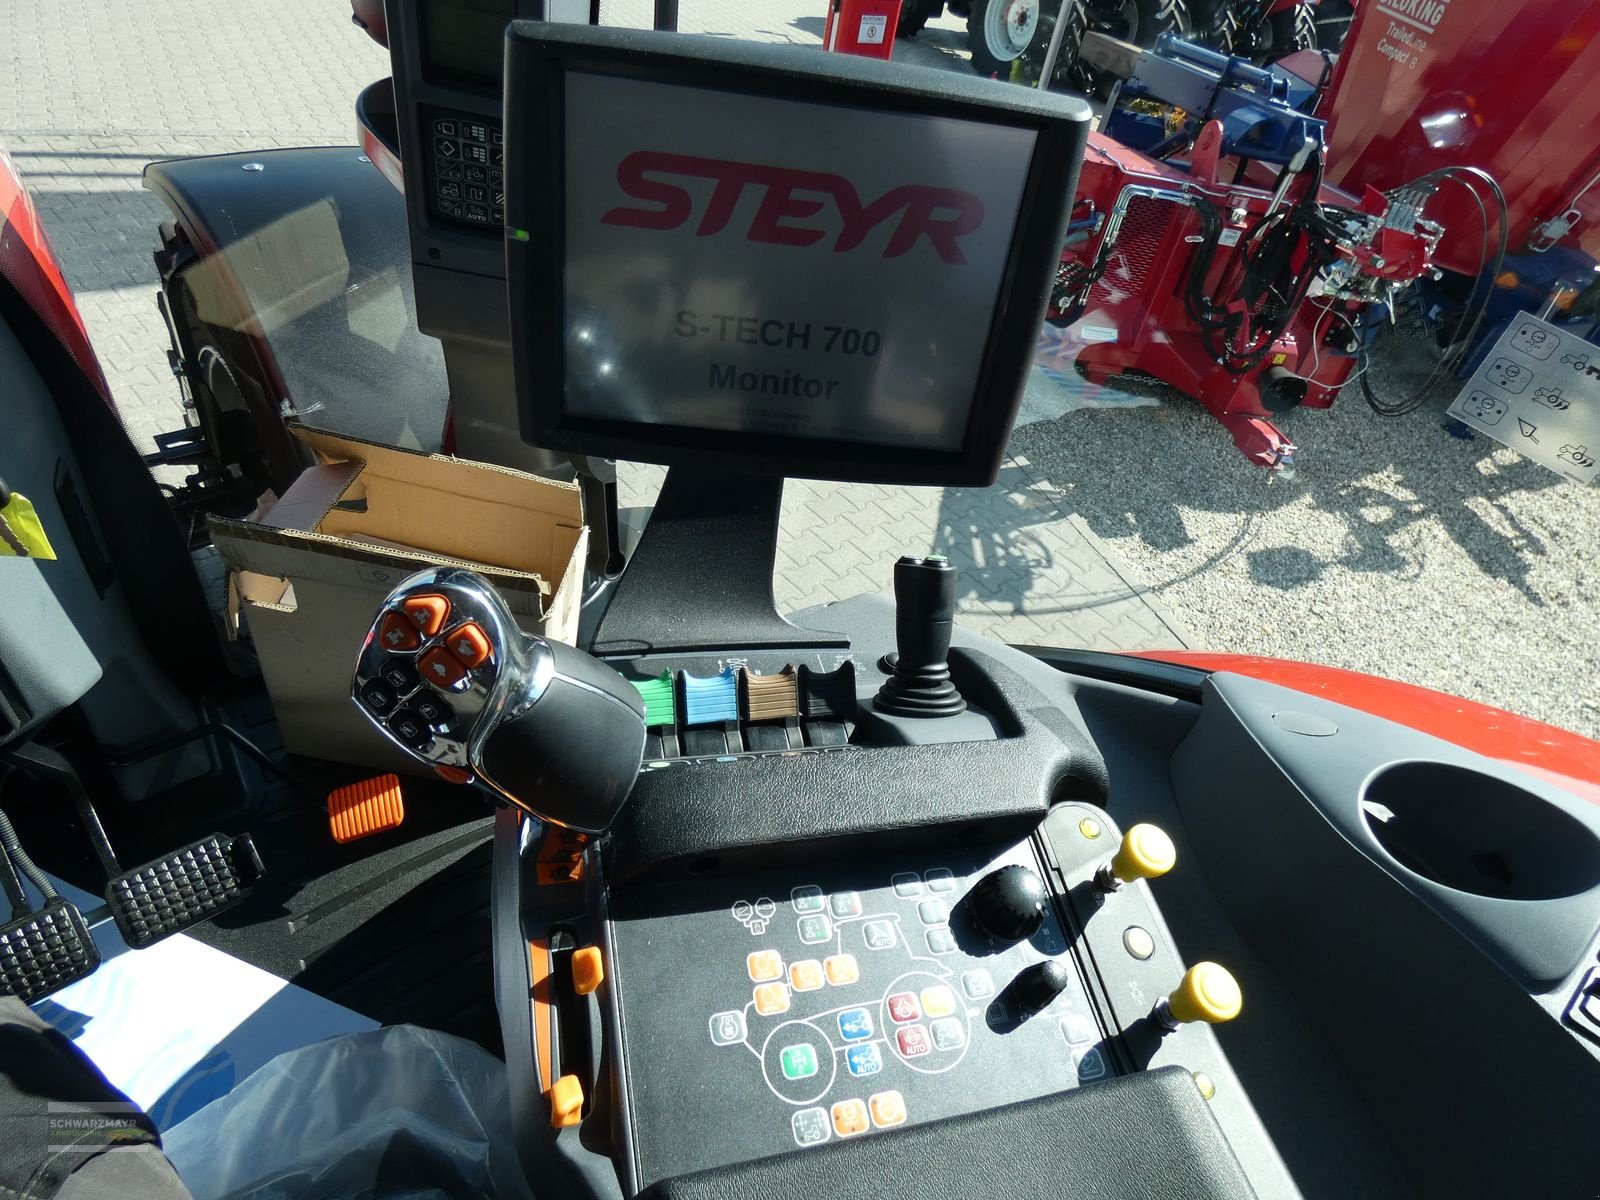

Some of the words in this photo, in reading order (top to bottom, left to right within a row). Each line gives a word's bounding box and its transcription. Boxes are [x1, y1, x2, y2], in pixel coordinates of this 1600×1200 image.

[1380, 0, 1446, 26] KING
[1386, 21, 1427, 52] TrailedLine
[1376, 38, 1410, 63] Compact
[1408, 57, 1418, 70] 8
[467, 213, 487, 222] AUTO
[600, 150, 985, 266] STEYR
[674, 310, 812, 350] S-TECH
[823, 326, 882, 357] 700
[708, 362, 840, 400] Monitor
[906, 1045, 926, 1056] AUTO
[857, 1062, 877, 1074] AUTO
